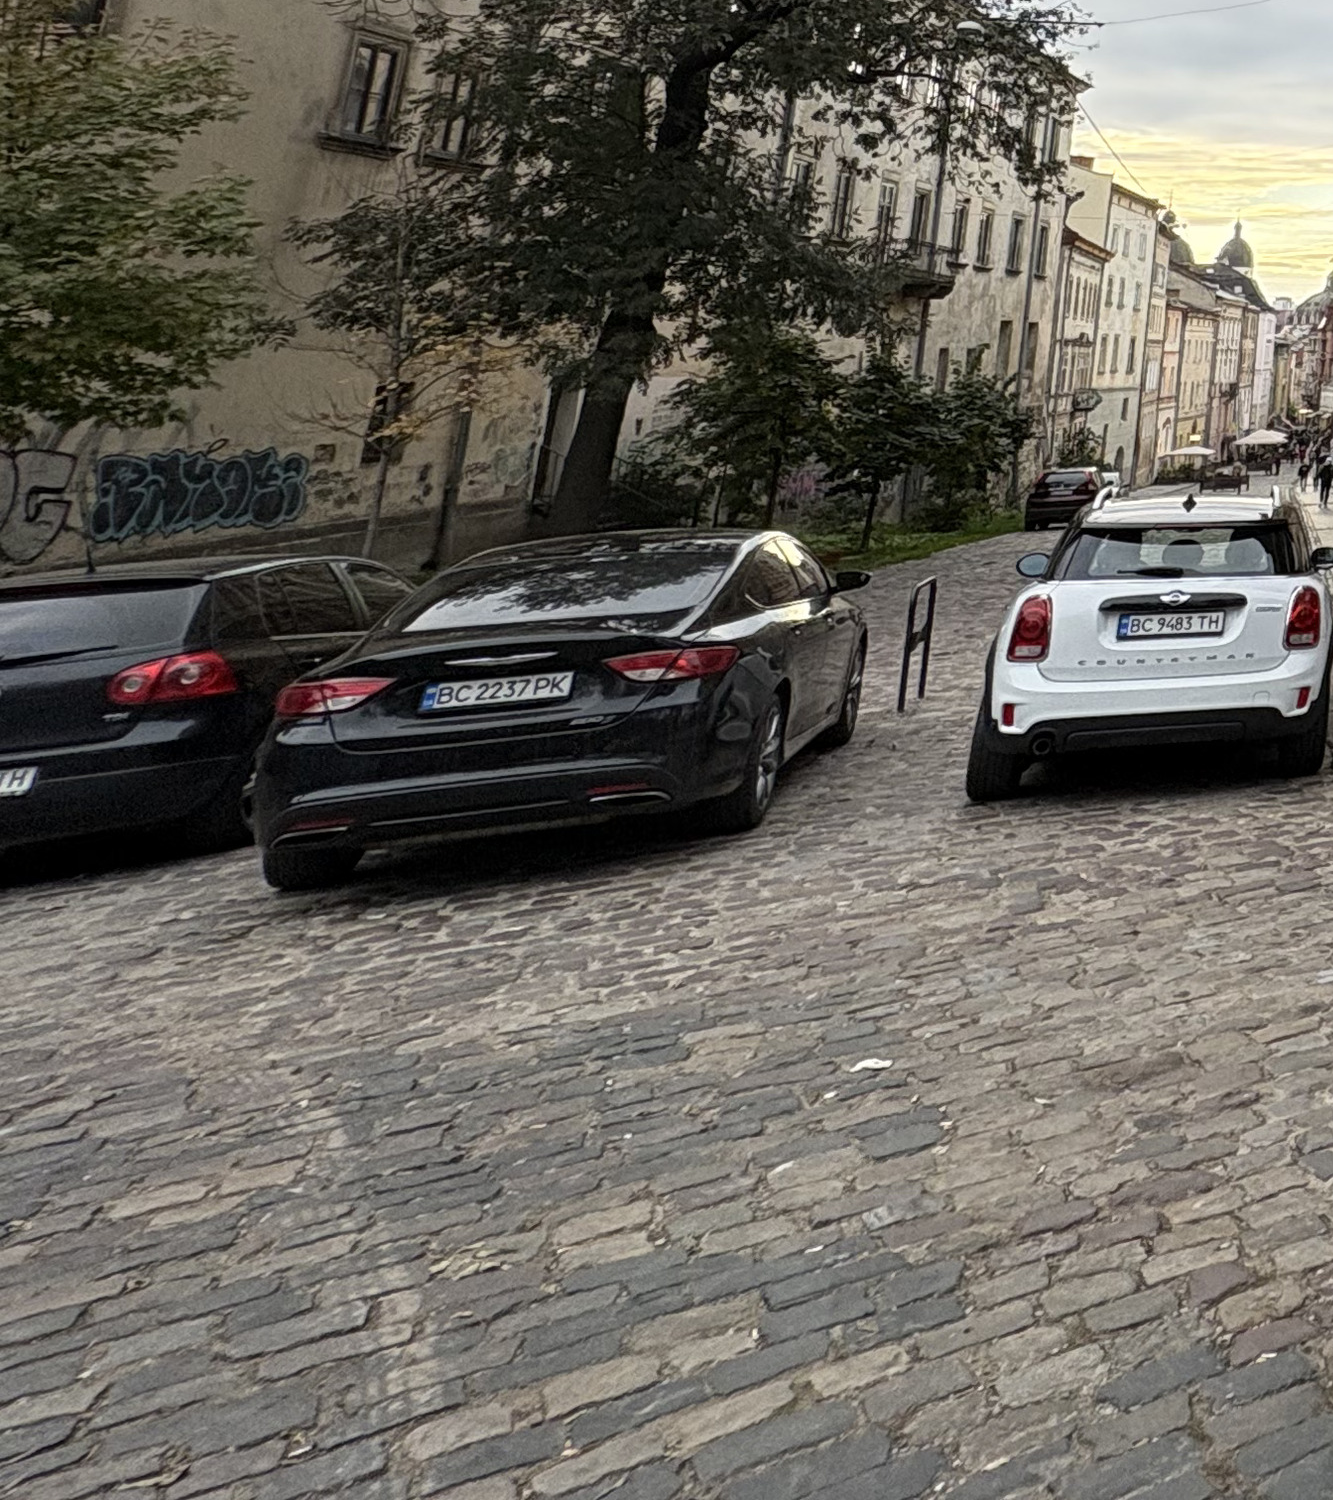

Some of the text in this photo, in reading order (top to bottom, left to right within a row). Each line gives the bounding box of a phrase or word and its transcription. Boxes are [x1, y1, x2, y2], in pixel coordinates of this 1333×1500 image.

[1130, 614, 1219, 634] BC 9483 TH
[436, 674, 569, 705] BC 2237 PK
